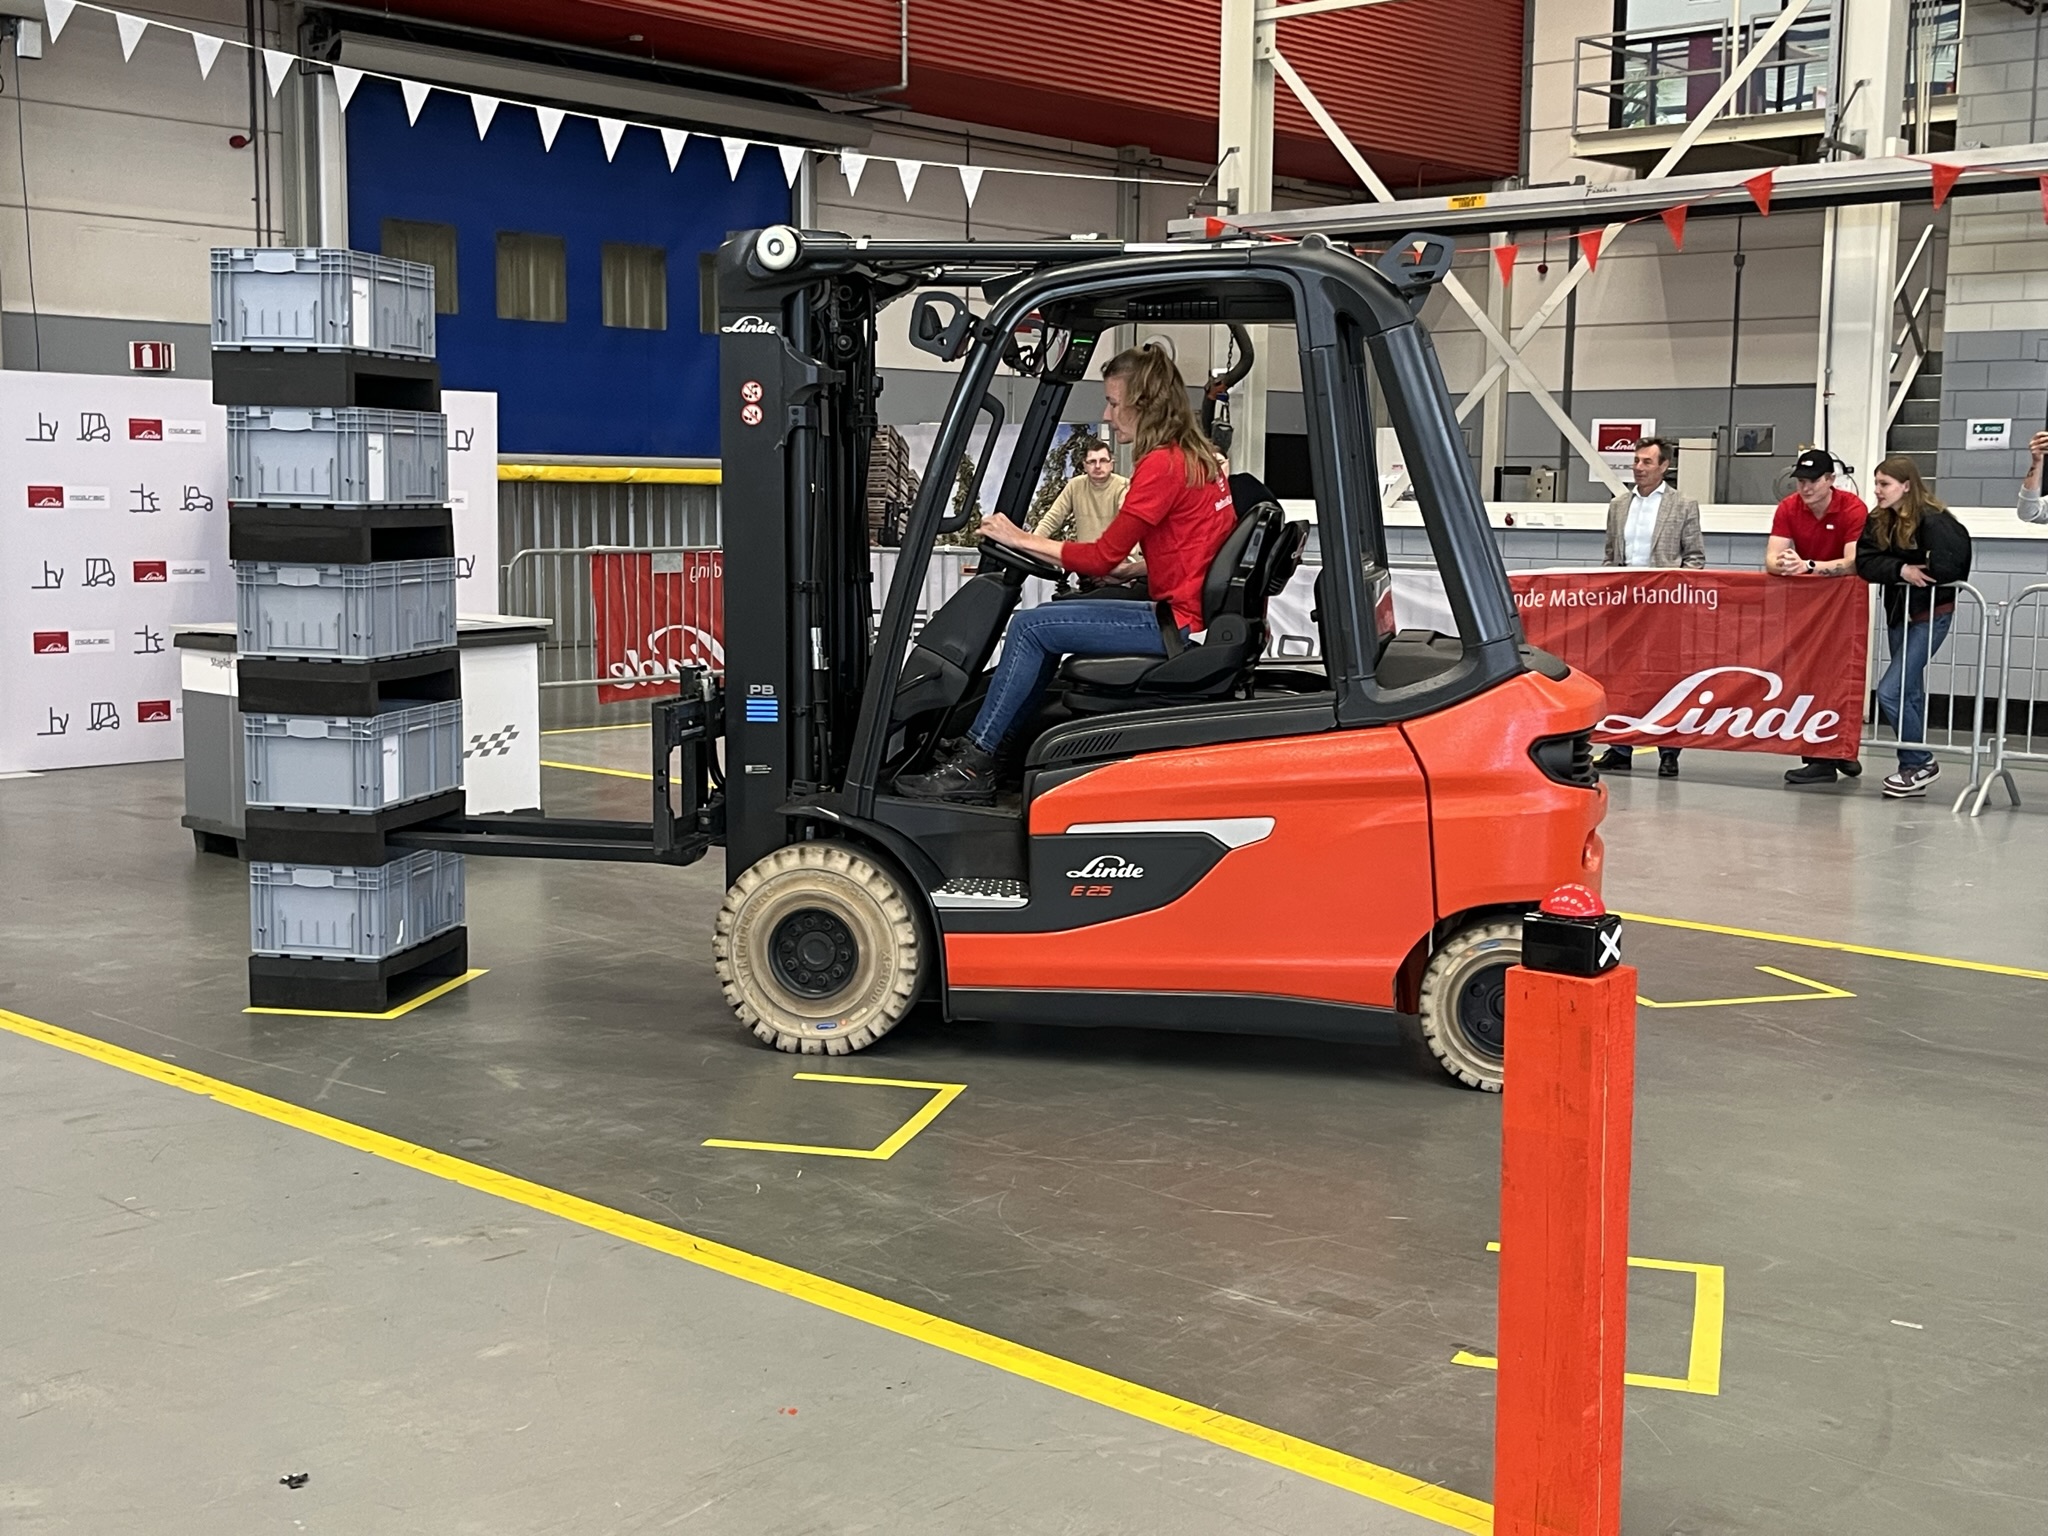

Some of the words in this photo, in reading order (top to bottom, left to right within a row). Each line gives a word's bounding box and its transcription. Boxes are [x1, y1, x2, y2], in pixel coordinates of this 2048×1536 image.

[721, 315, 777, 334] Linde
[1514, 588, 1545, 608] nde
[1550, 585, 1627, 608] Material
[1633, 583, 1718, 610] Handling
[749, 684, 775, 695] PB
[1594, 666, 1840, 744] Linde
[1066, 855, 1144, 878] Linde
[1070, 885, 1086, 897] E
[1086, 885, 1113, 897] 25
